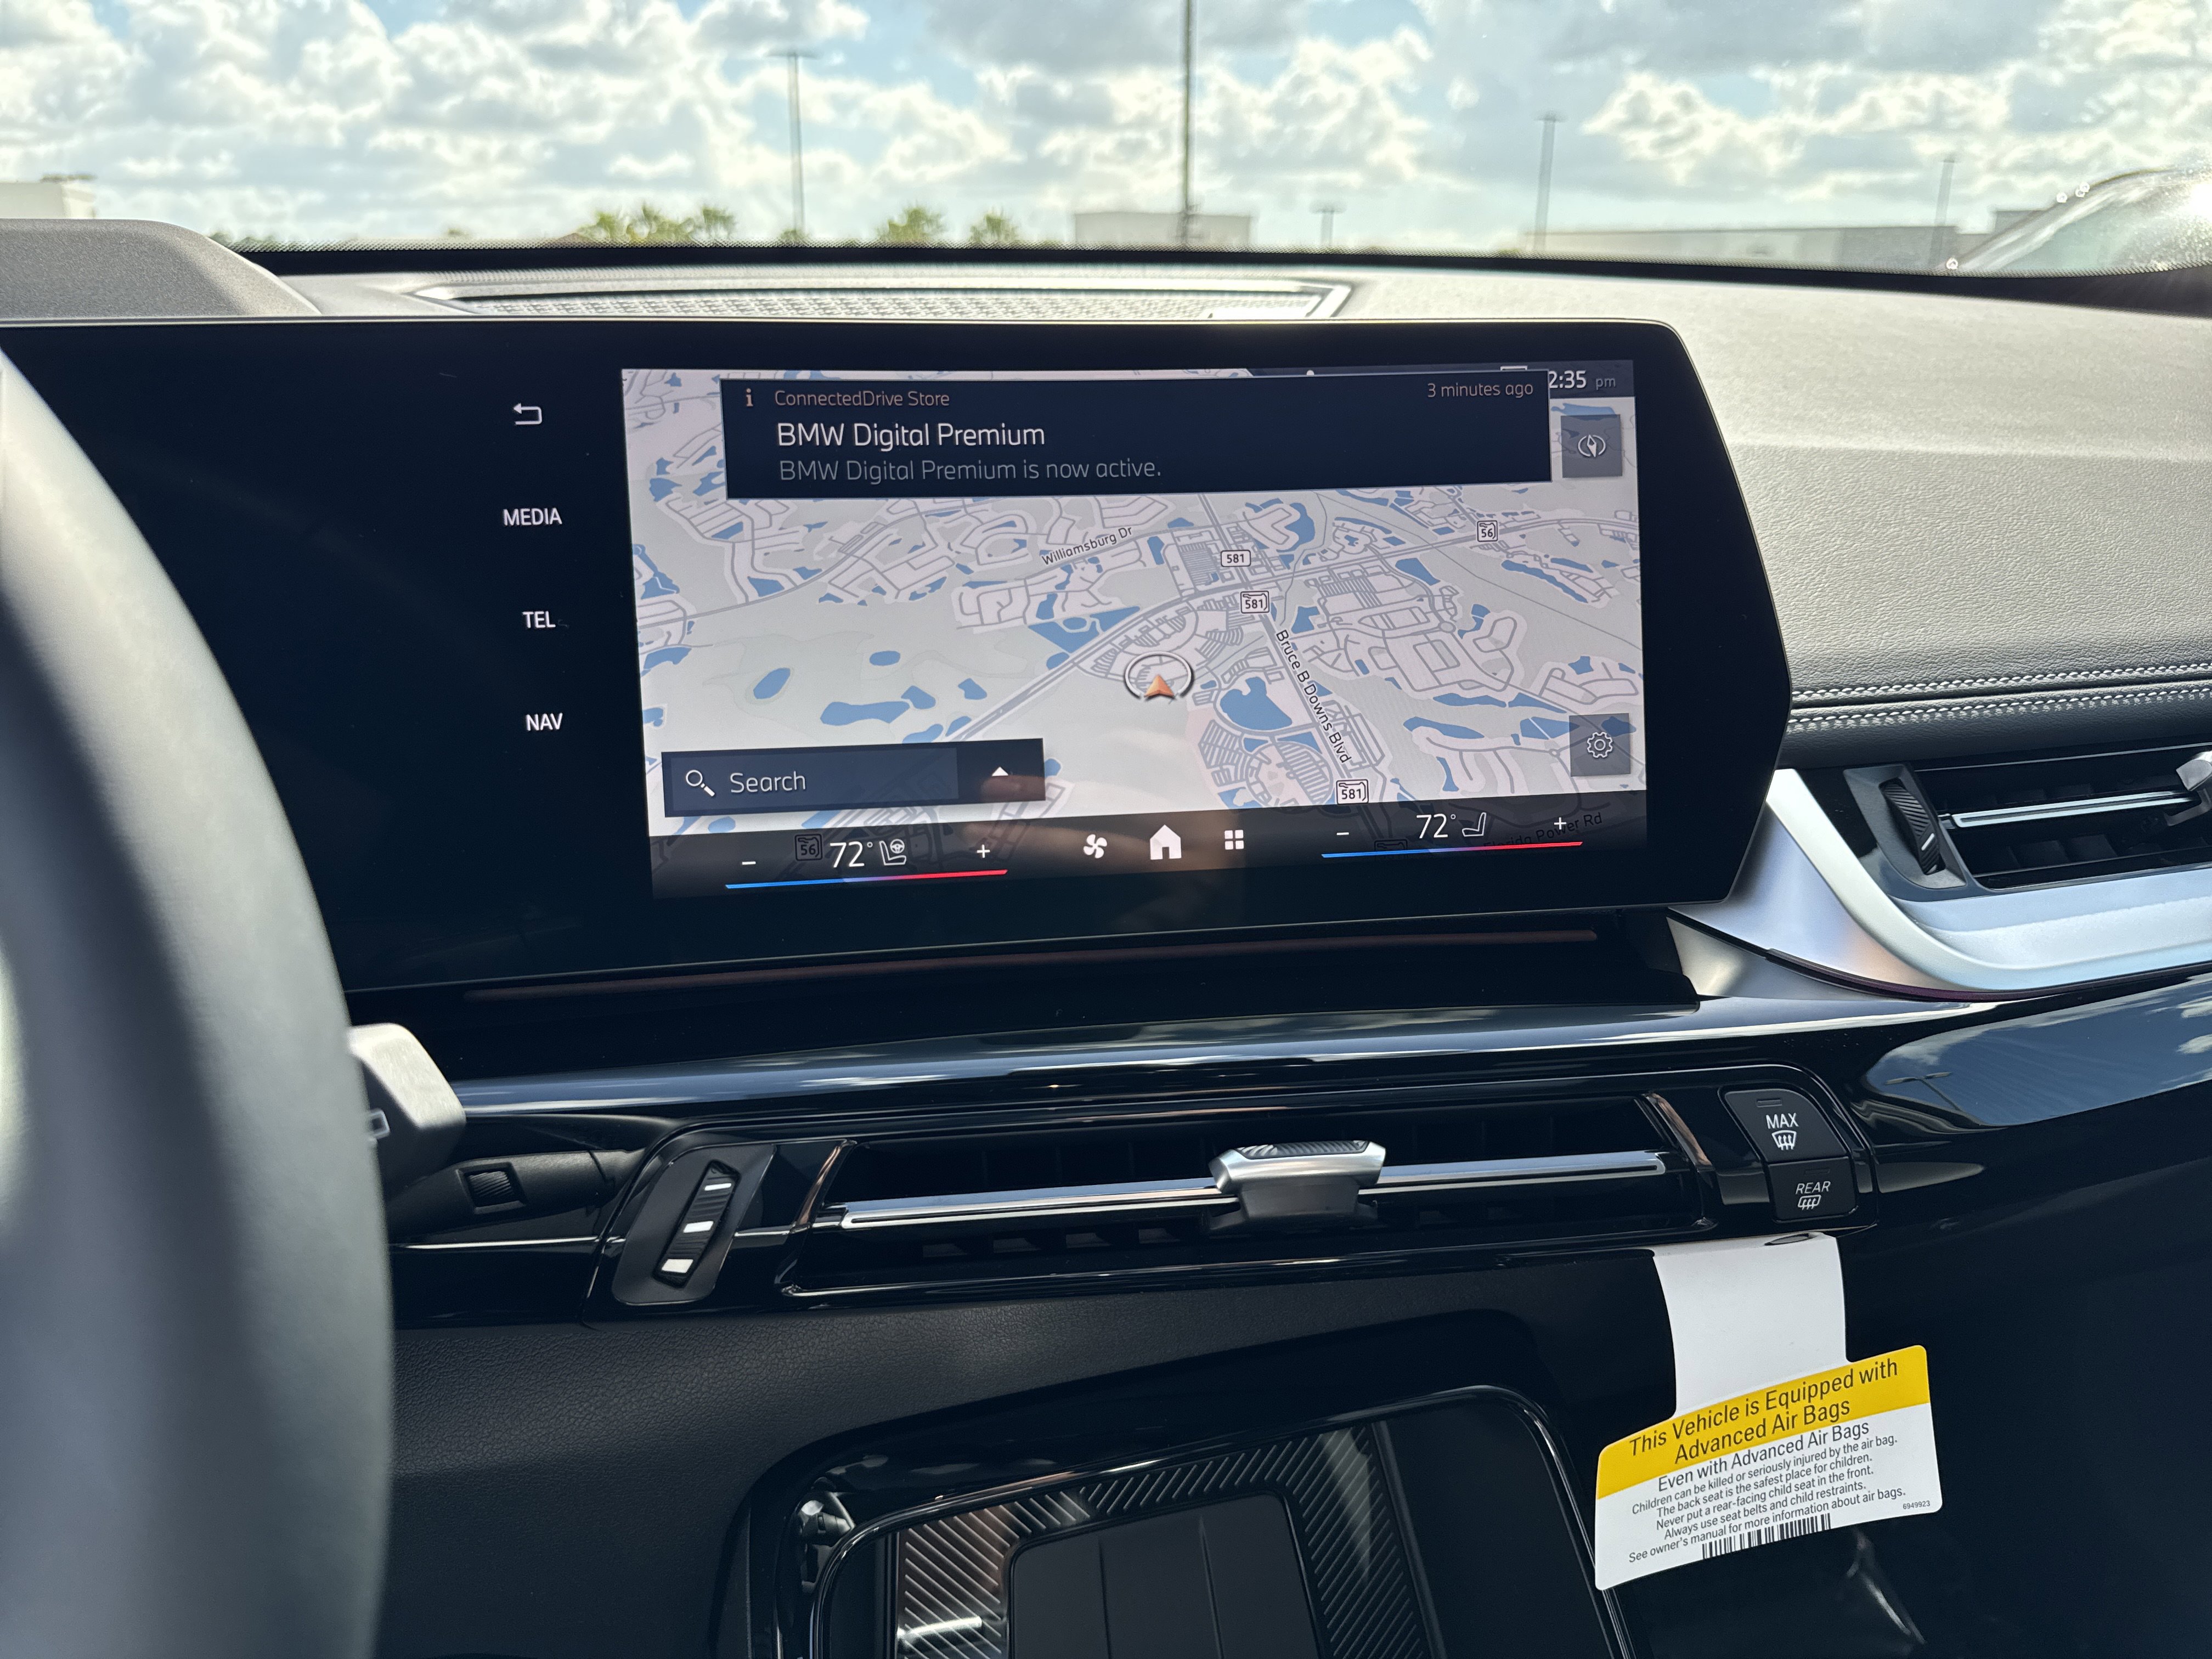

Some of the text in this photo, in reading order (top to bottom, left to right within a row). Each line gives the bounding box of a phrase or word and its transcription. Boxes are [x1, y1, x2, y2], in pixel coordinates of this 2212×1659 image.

[1427, 382, 1533, 398] 3 minutes ago
[1595, 377, 1616, 390] pm
[775, 390, 950, 407] ConnectedDrive Store
[777, 422, 1045, 452] BMW Digital Premium
[780, 458, 1161, 485] BMW Digital Premium is now active.
[503, 507, 562, 526] MEDIA
[1481, 528, 1493, 538] 56
[1041, 527, 1132, 566] Williamsburg Dr
[1227, 554, 1244, 563] 581
[1245, 599, 1263, 609] 581
[522, 611, 556, 628] TEL
[1276, 630, 1352, 763] Bruce B Downs Blvd
[526, 713, 563, 731] NAV
[730, 770, 806, 793] Search
[1341, 788, 1361, 800] 581
[1536, 818, 1579, 839] Power
[1583, 812, 1602, 827] Rd
[800, 844, 816, 856] 56
[1765, 1113, 1799, 1129] MAX
[1795, 1181, 1831, 1195] REAR
[1629, 1358, 1898, 1456] This Vehicle is Equipped with
[1675, 1400, 1850, 1465] Advanced Air Bags
[1658, 1422, 1870, 1492] Even with Advanced Air Bags
[1632, 1435, 1898, 1515] Children can be killed or seriously injured by the air bag.
[1656, 1453, 1872, 1518] The back seat is the safest place for children.
[1656, 1464, 1874, 1531] Never put a rear-facing child seat in the front.
[1903, 1500, 1931, 1510] 6949923
[1664, 1481, 1866, 1540] Always use seat belts and child restraints.
[1629, 1551, 1648, 1563] See
[1690, 1525, 1726, 1545] manual
[1729, 1521, 1743, 1534] for
[1744, 1515, 1771, 1530] more
[1772, 1501, 1829, 1523] information
[1831, 1493, 1860, 1509] about
[1863, 1491, 1875, 1503] air
[1877, 1487, 1906, 1500] bags.
